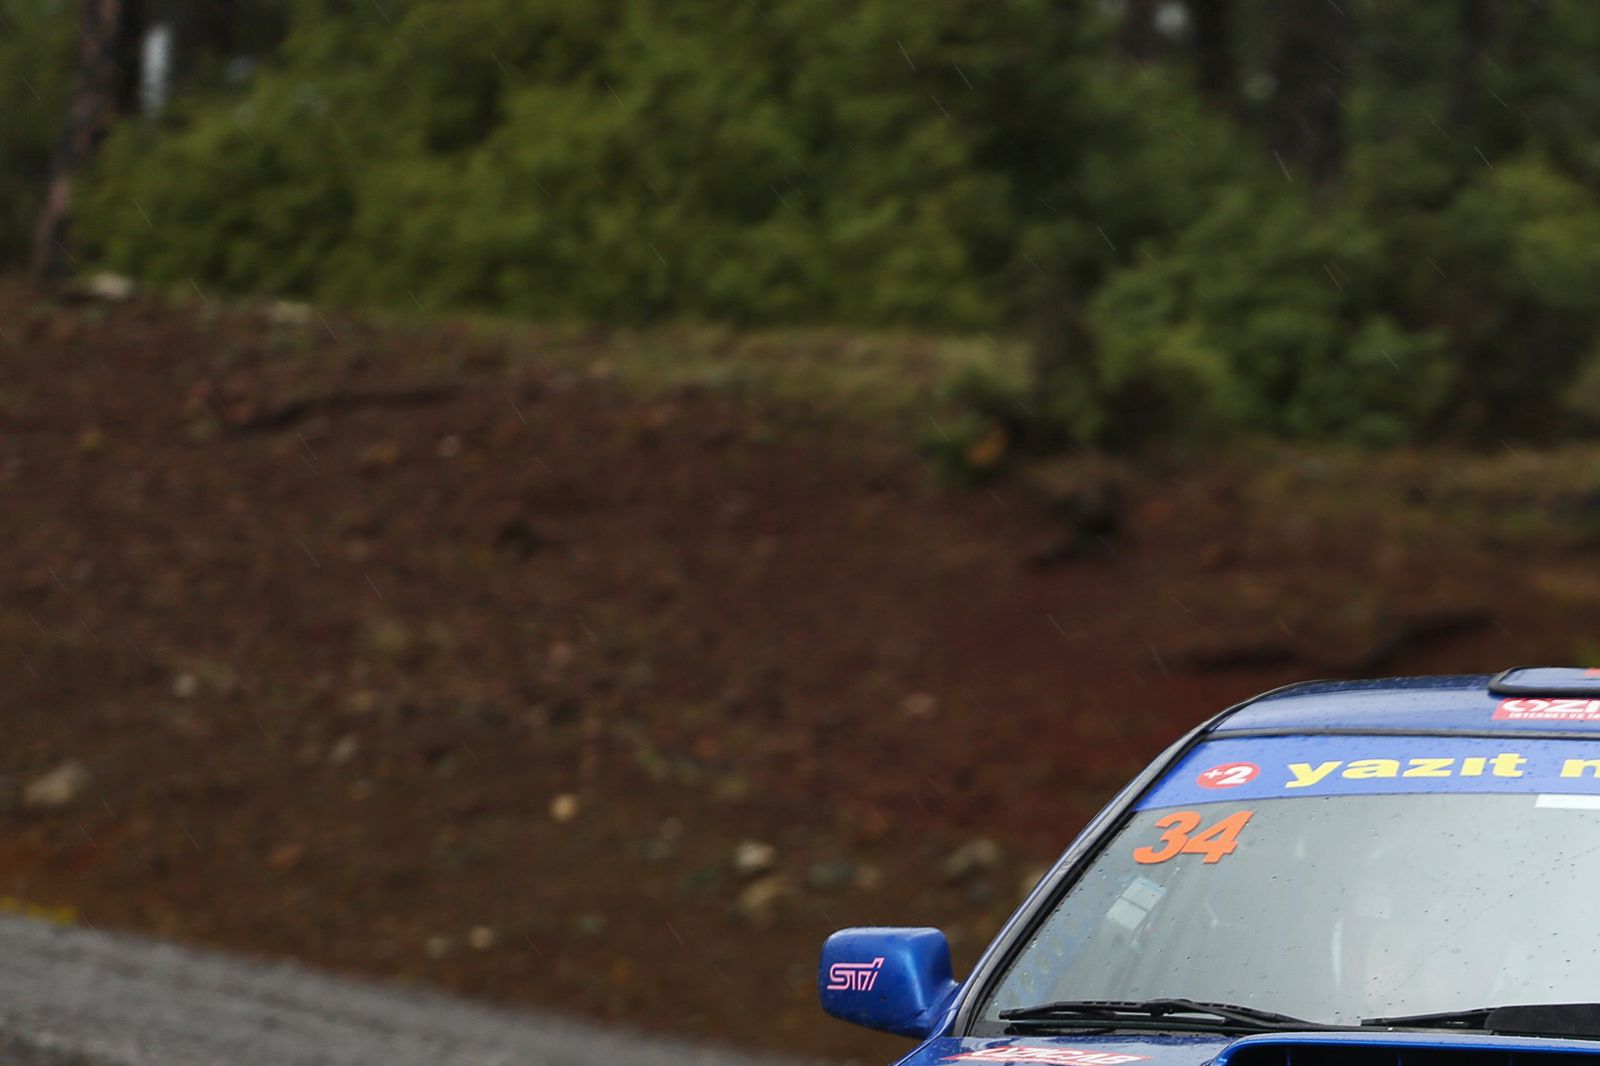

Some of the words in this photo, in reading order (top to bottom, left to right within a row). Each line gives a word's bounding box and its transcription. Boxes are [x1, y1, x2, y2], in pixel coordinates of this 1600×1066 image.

[1203, 765, 1254, 785] +2
[1284, 753, 1528, 788] yazıt
[1133, 811, 1255, 865] 34
